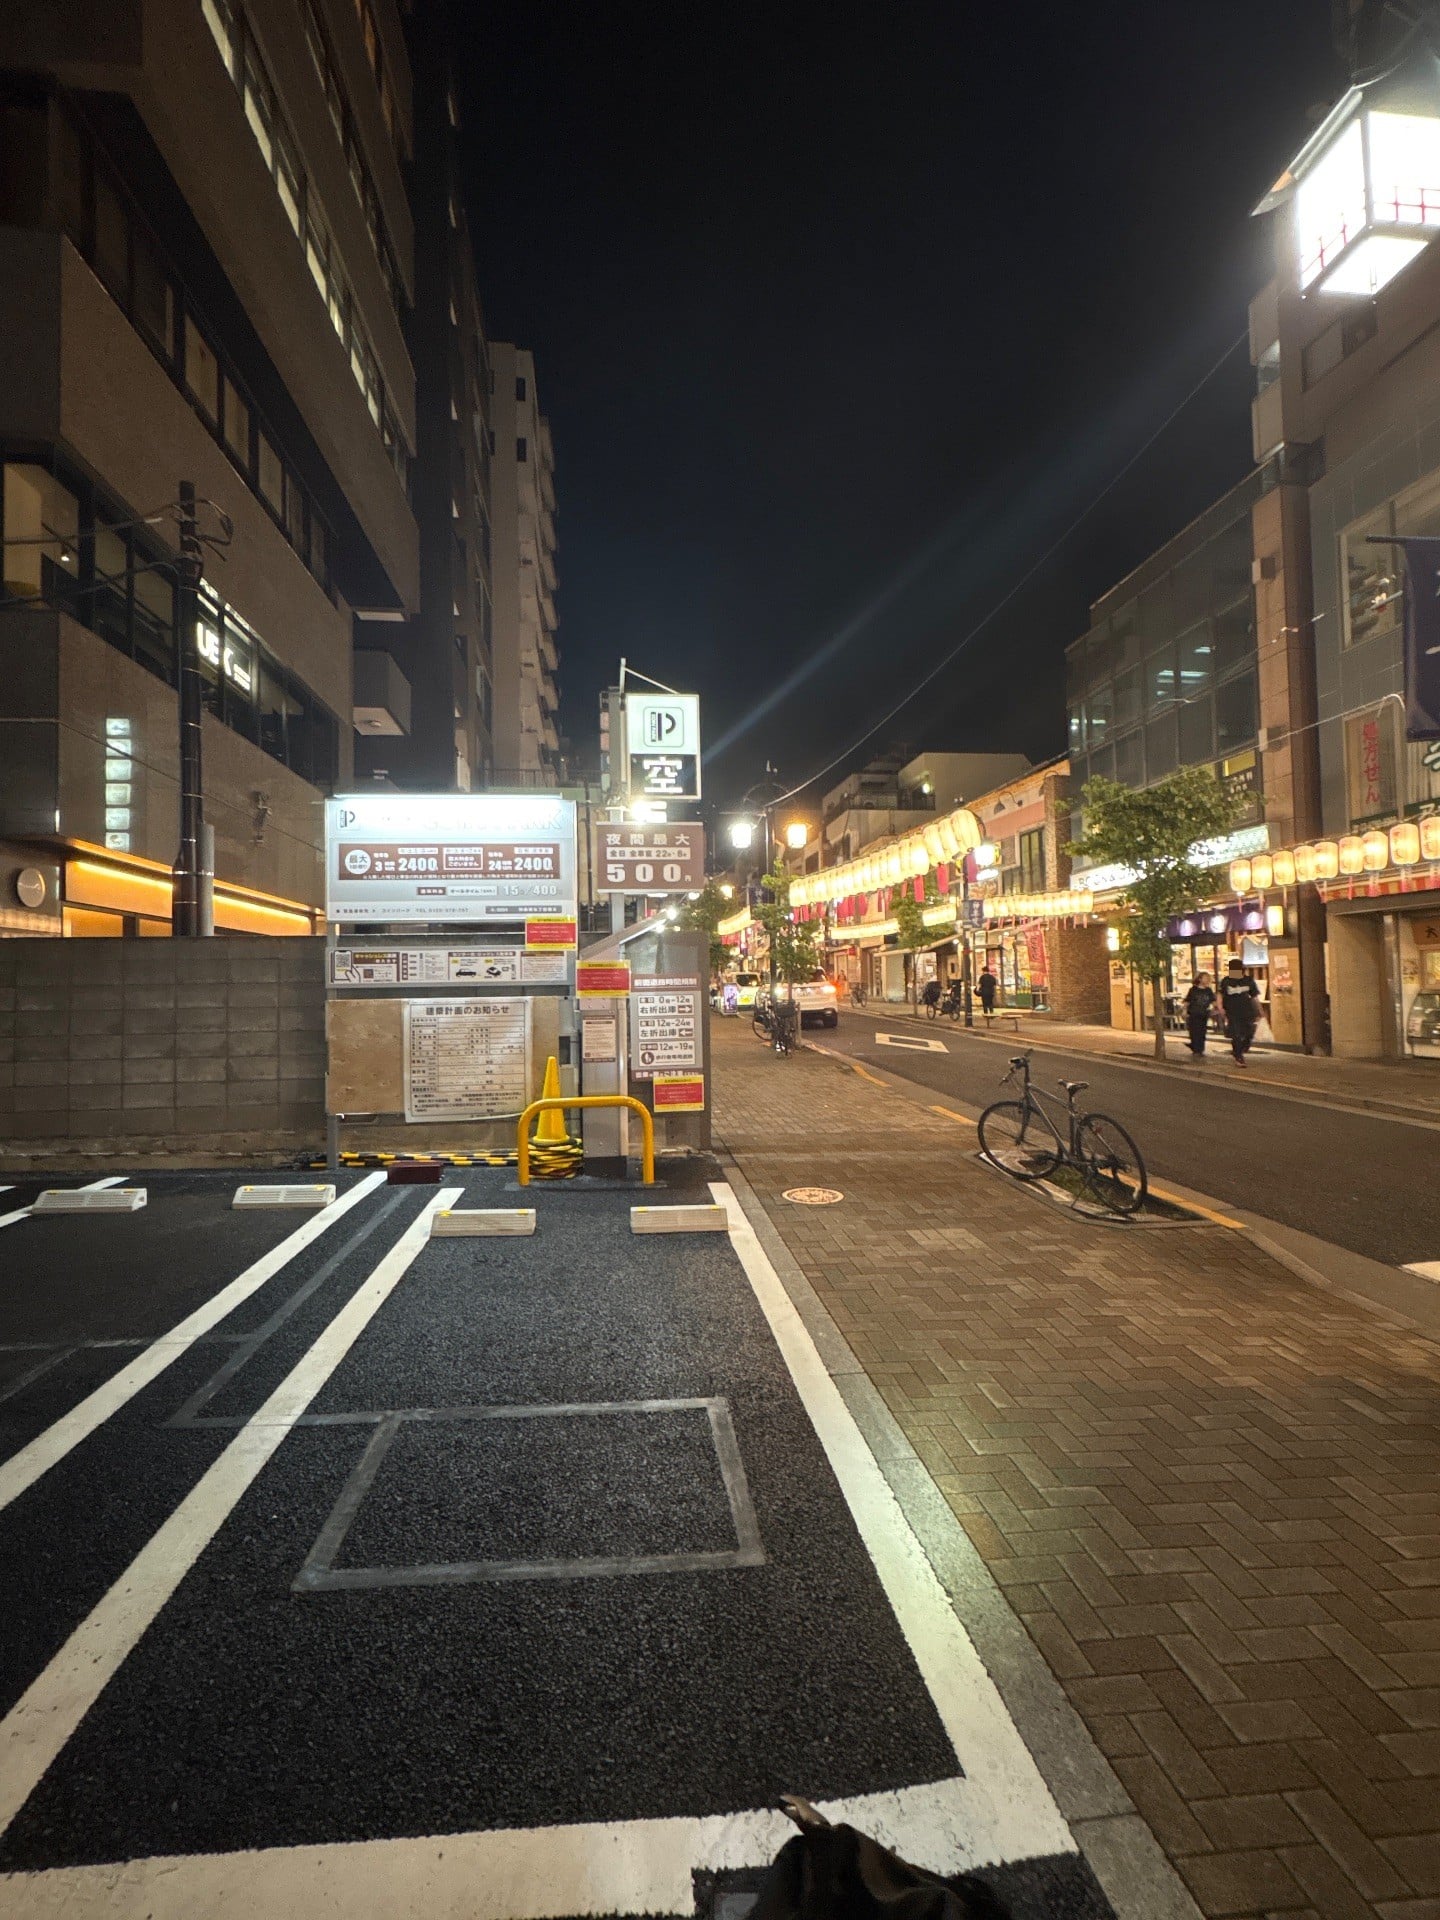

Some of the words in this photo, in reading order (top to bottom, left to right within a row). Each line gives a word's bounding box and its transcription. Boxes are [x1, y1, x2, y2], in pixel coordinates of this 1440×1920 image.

[643, 756, 683, 794] 空
[606, 833, 690, 845] 夜間最大
[349, 854, 368, 863] 最大
[375, 860, 383, 871] 3
[398, 857, 438, 871] 2400
[488, 860, 502, 870] 24
[514, 857, 553, 870] 2400
[606, 863, 692, 883] 500円
[426, 1004, 510, 1016] 建築計画のお知らせ
[640, 1005, 676, 1014] 右折出庫
[640, 1029, 677, 1037] 左折出庫
